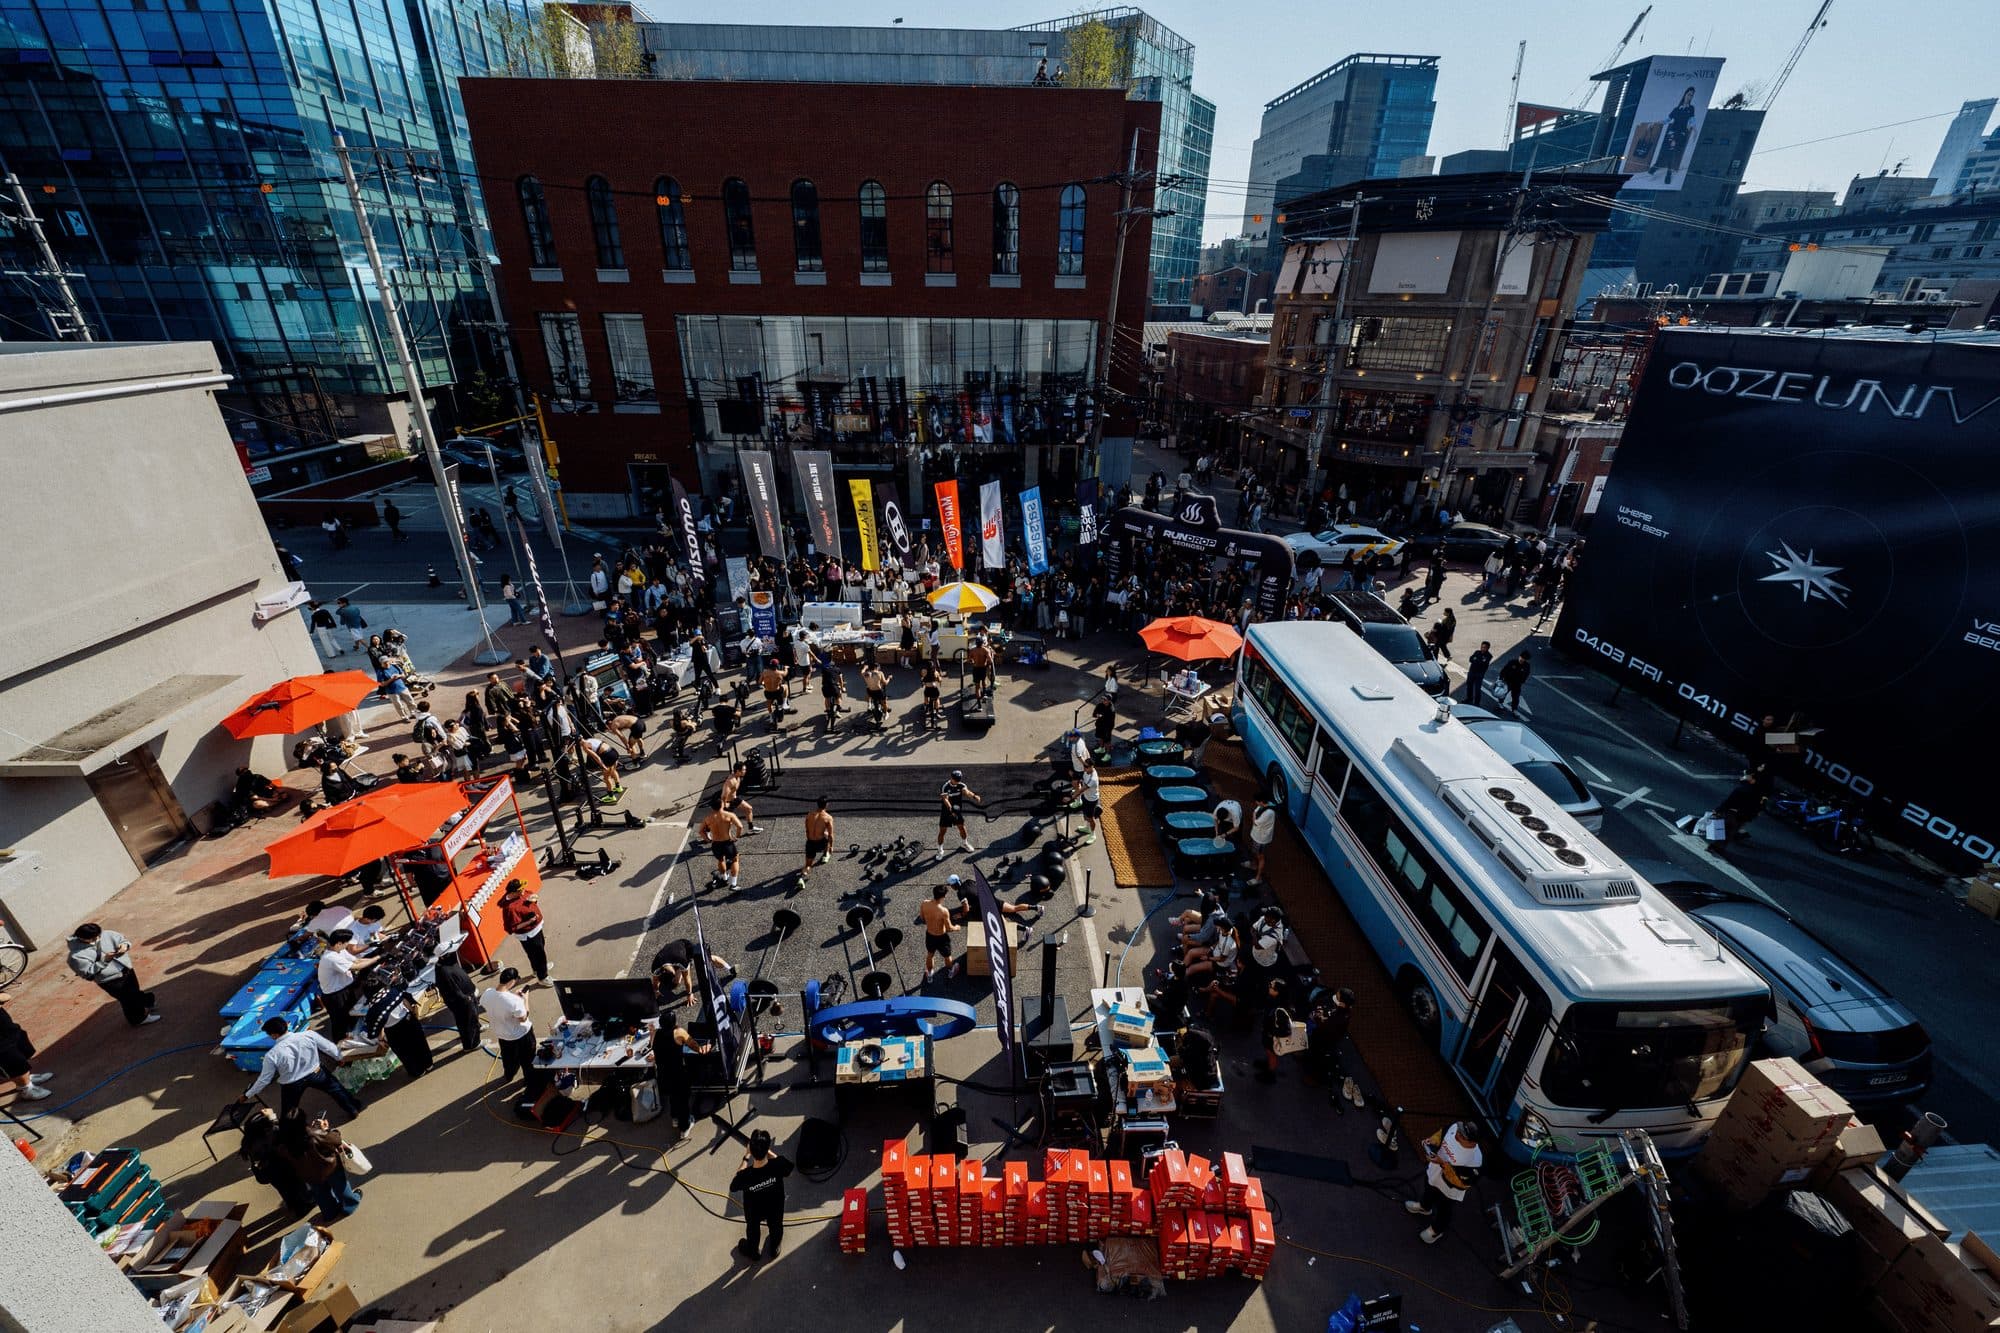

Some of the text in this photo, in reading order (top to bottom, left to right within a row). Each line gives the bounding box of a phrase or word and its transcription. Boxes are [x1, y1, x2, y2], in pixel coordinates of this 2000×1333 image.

[836, 416, 869, 430] KITH
[1163, 529, 1217, 548] RUNDROP
[1574, 627, 1625, 665] 04.03
[1626, 655, 1663, 684] FRI
[1677, 682, 1728, 719] 04.11
[1804, 747, 1874, 798] 11:00
[1575, 1136, 1622, 1201] THE
